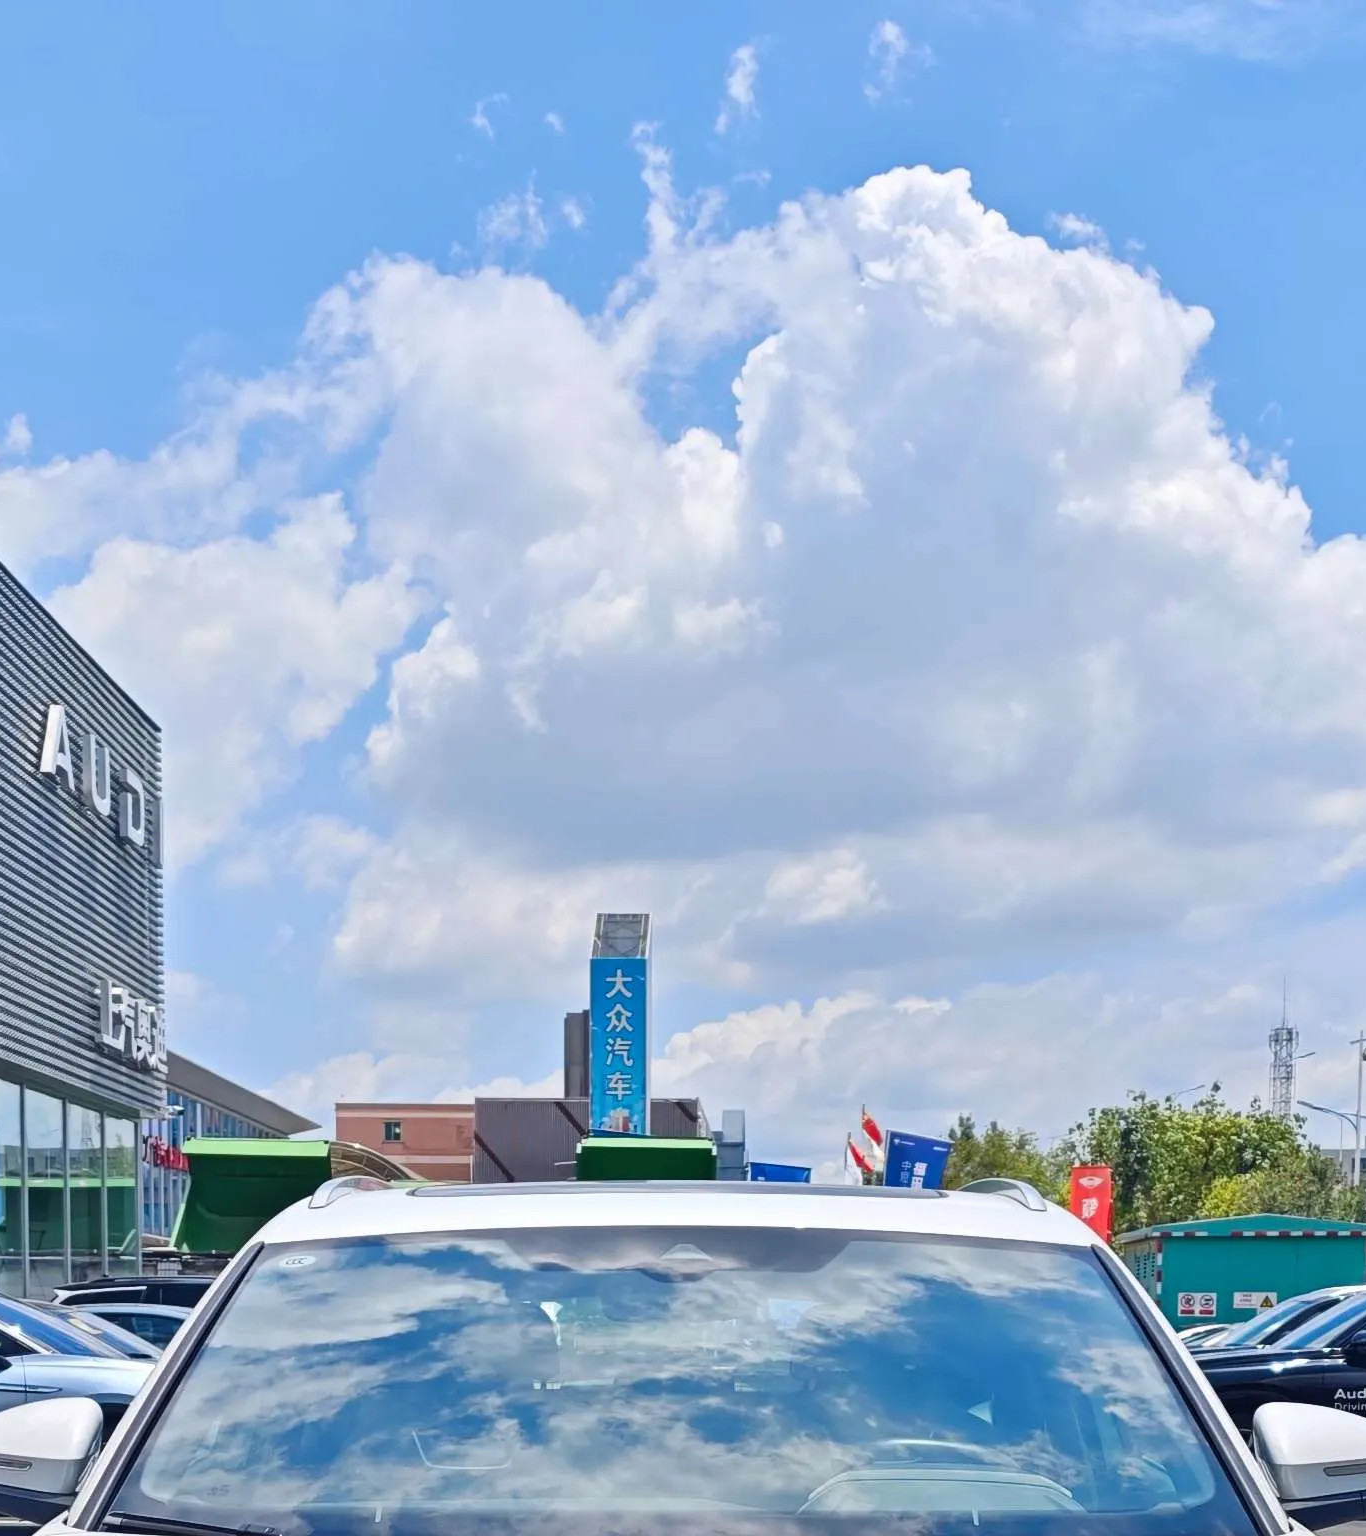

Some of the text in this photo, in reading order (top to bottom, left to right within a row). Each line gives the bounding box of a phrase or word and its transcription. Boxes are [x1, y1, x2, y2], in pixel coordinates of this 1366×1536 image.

[40, 704, 163, 868] AUDI
[606, 969, 633, 1100] 大众汽车
